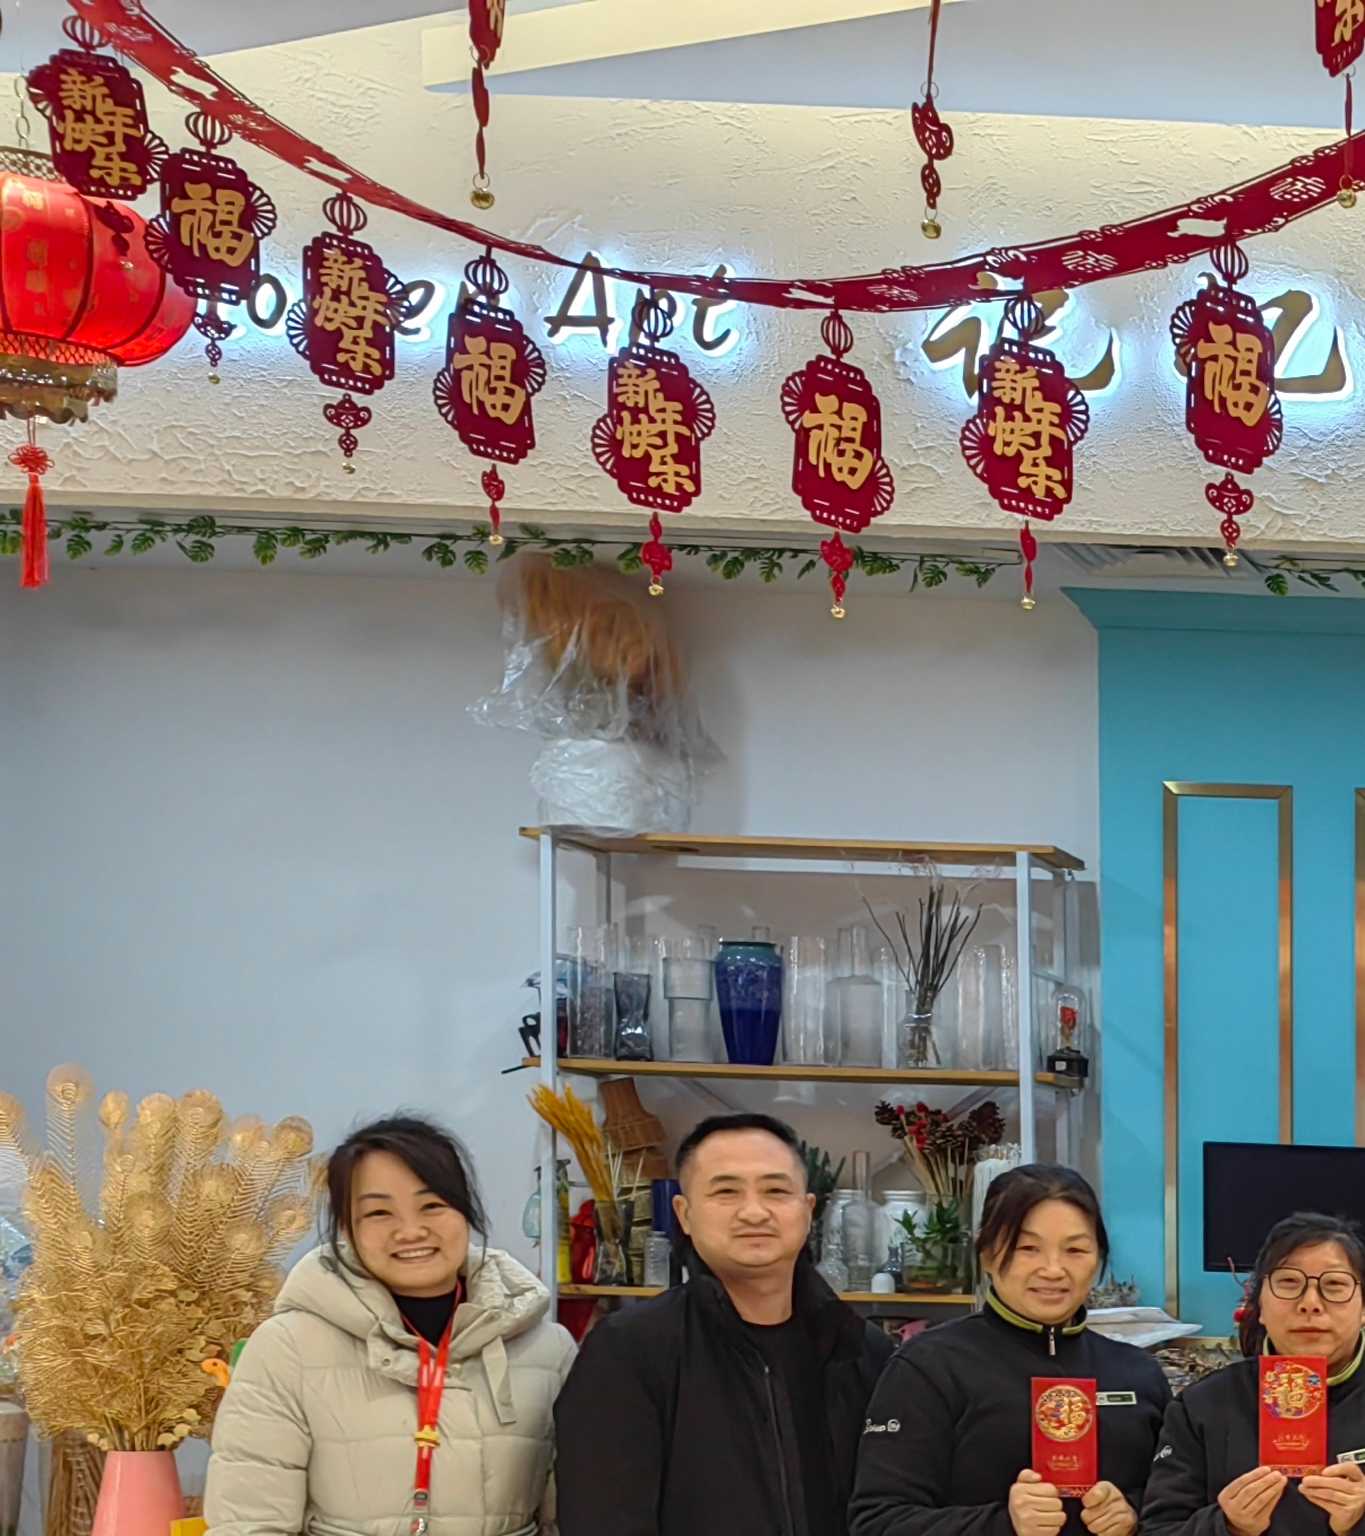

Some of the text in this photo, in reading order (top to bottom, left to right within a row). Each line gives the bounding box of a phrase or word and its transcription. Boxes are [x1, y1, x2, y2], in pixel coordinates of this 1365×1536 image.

[58, 67, 142, 188] 新年快乐
[171, 181, 255, 266] 福
[311, 248, 386, 378] 新年快乐
[453, 335, 526, 426] 福
[614, 365, 697, 496] 新年快乐
[987, 356, 1067, 500] 新年快乐
[1198, 323, 1265, 427] 福
[803, 393, 869, 490] 福
